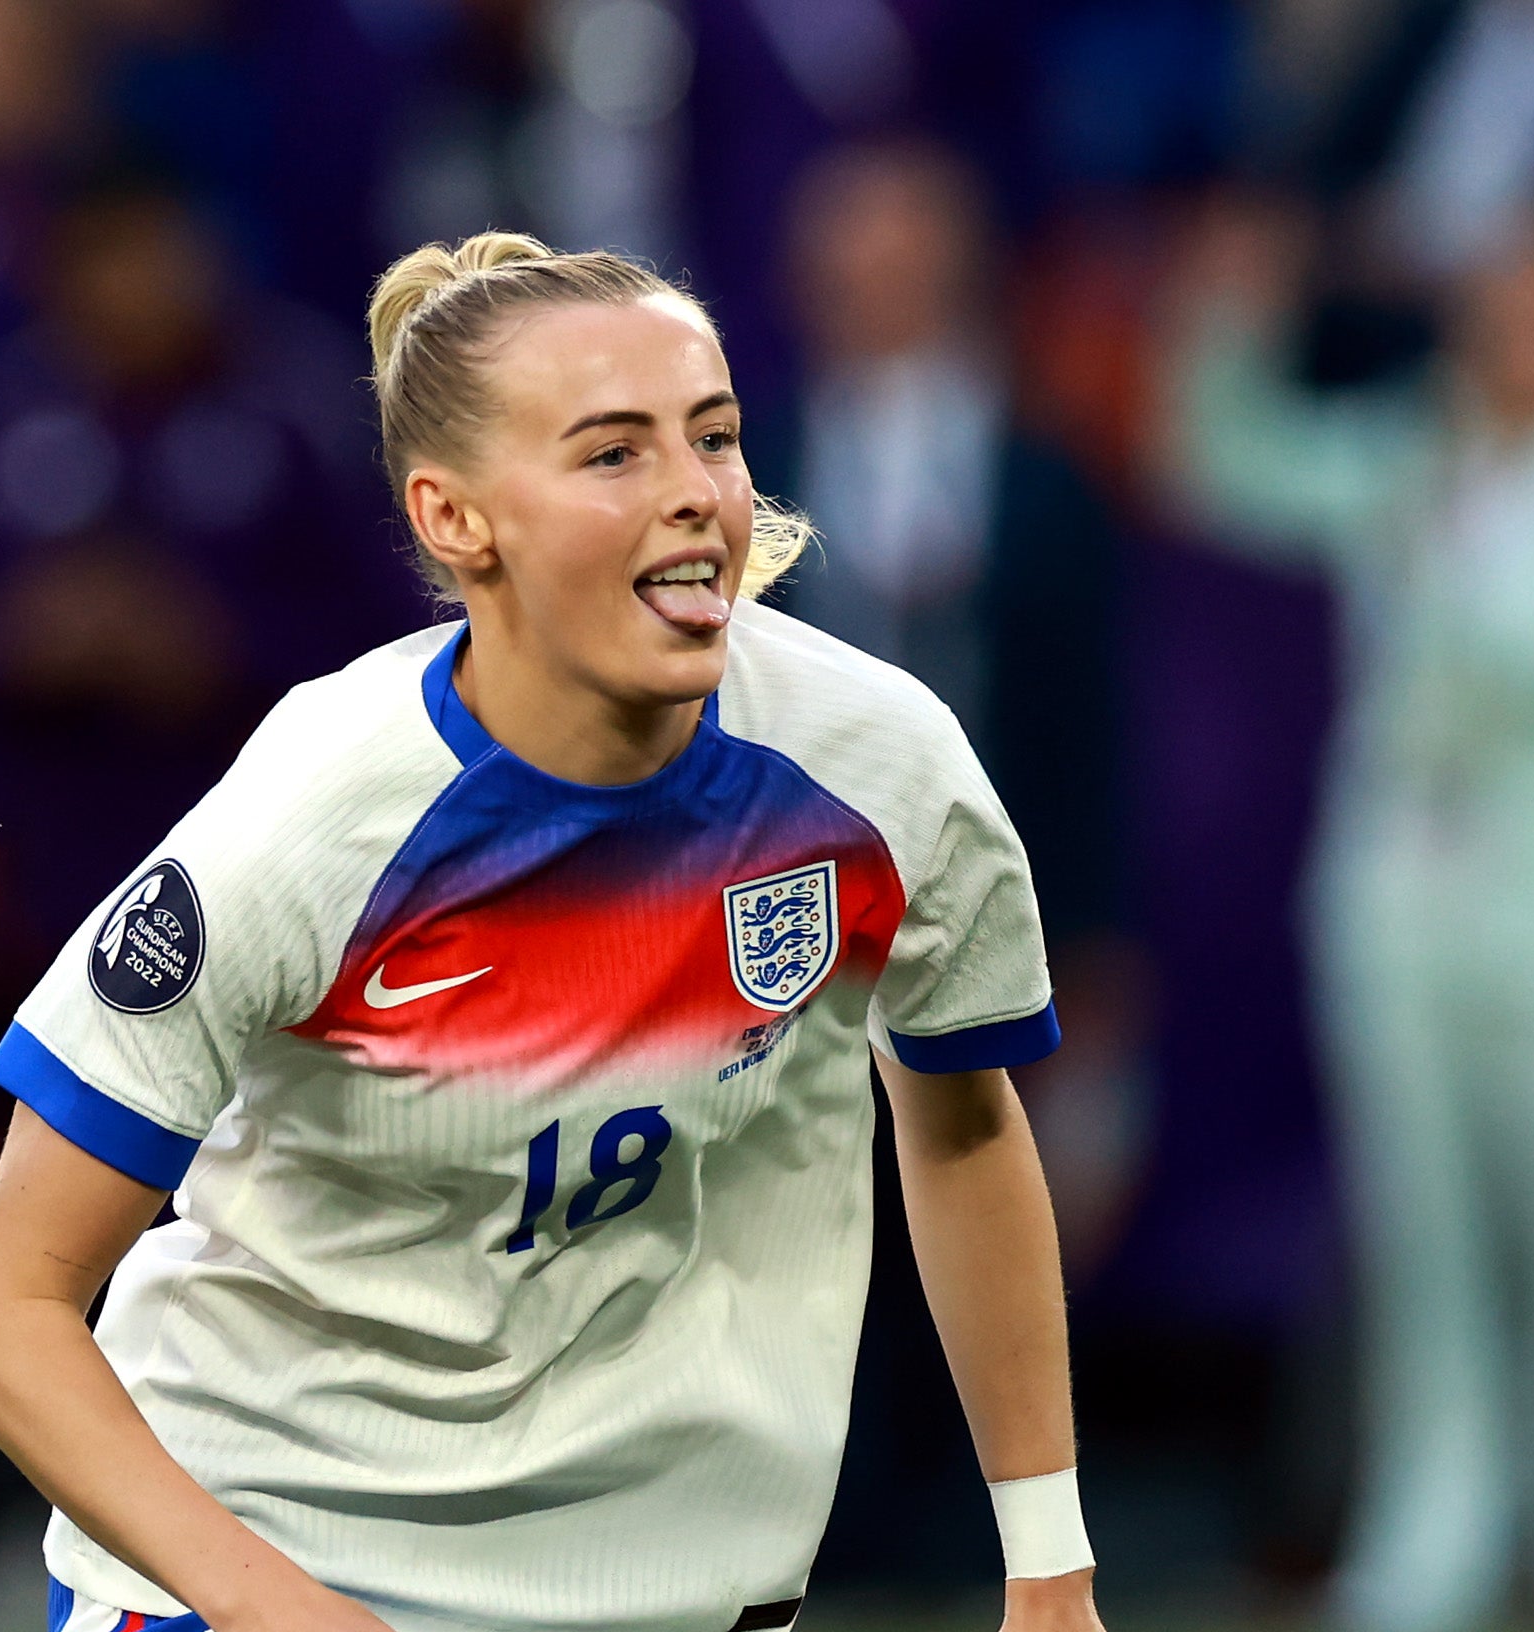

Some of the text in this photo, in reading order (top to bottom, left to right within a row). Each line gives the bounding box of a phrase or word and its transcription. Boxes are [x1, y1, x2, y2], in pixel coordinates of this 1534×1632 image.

[135, 916, 187, 966] EUROPEAN
[153, 912, 180, 940] UEFA
[125, 951, 163, 987] 2022
[126, 927, 184, 980] CHAMPIONS
[719, 1062, 740, 1082] UEFA
[506, 1105, 672, 1254] 18
